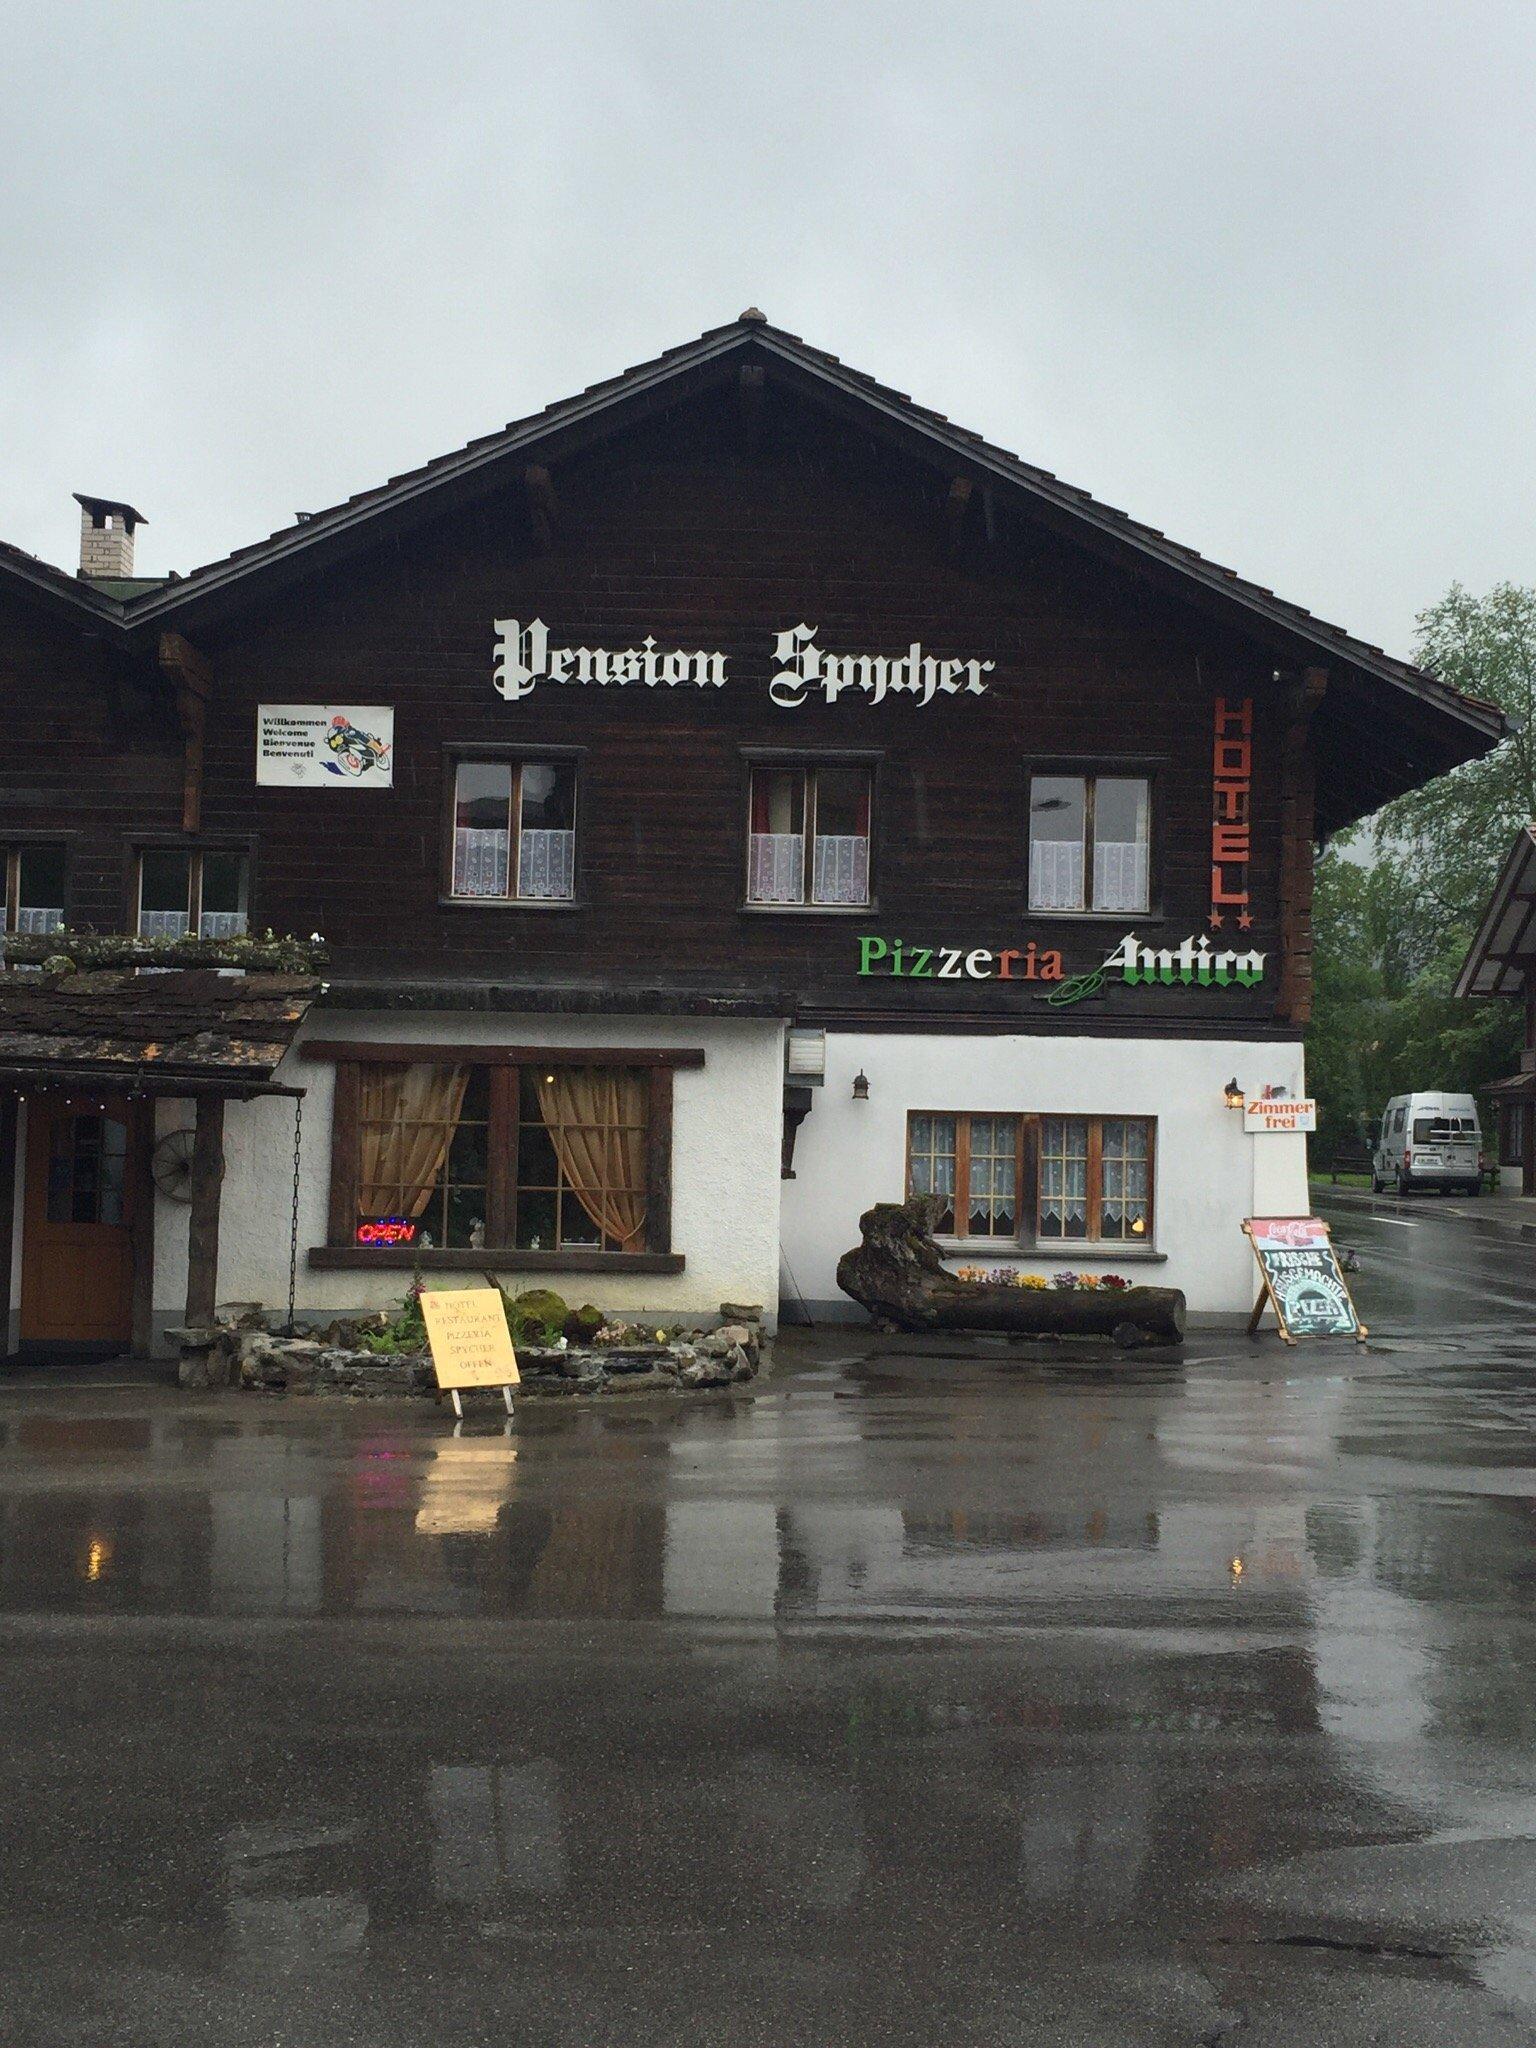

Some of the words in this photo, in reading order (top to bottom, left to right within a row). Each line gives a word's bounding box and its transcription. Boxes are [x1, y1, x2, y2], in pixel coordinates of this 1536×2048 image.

[493, 616, 729, 701] Pension
[768, 621, 996, 709] Spycher
[262, 717, 327, 727] Willkommen
[262, 729, 309, 738] Welcome
[262, 738, 316, 748] Bienvenue
[262, 749, 314, 758] Benvenuti
[1211, 698, 1252, 904] HOTEL
[856, 936, 1065, 981] Pizzeria
[1102, 931, 1267, 988] Antico
[1247, 1101, 1314, 1115] Zimmer
[1264, 1115, 1296, 1129] frei
[357, 1223, 416, 1242] OPEN
